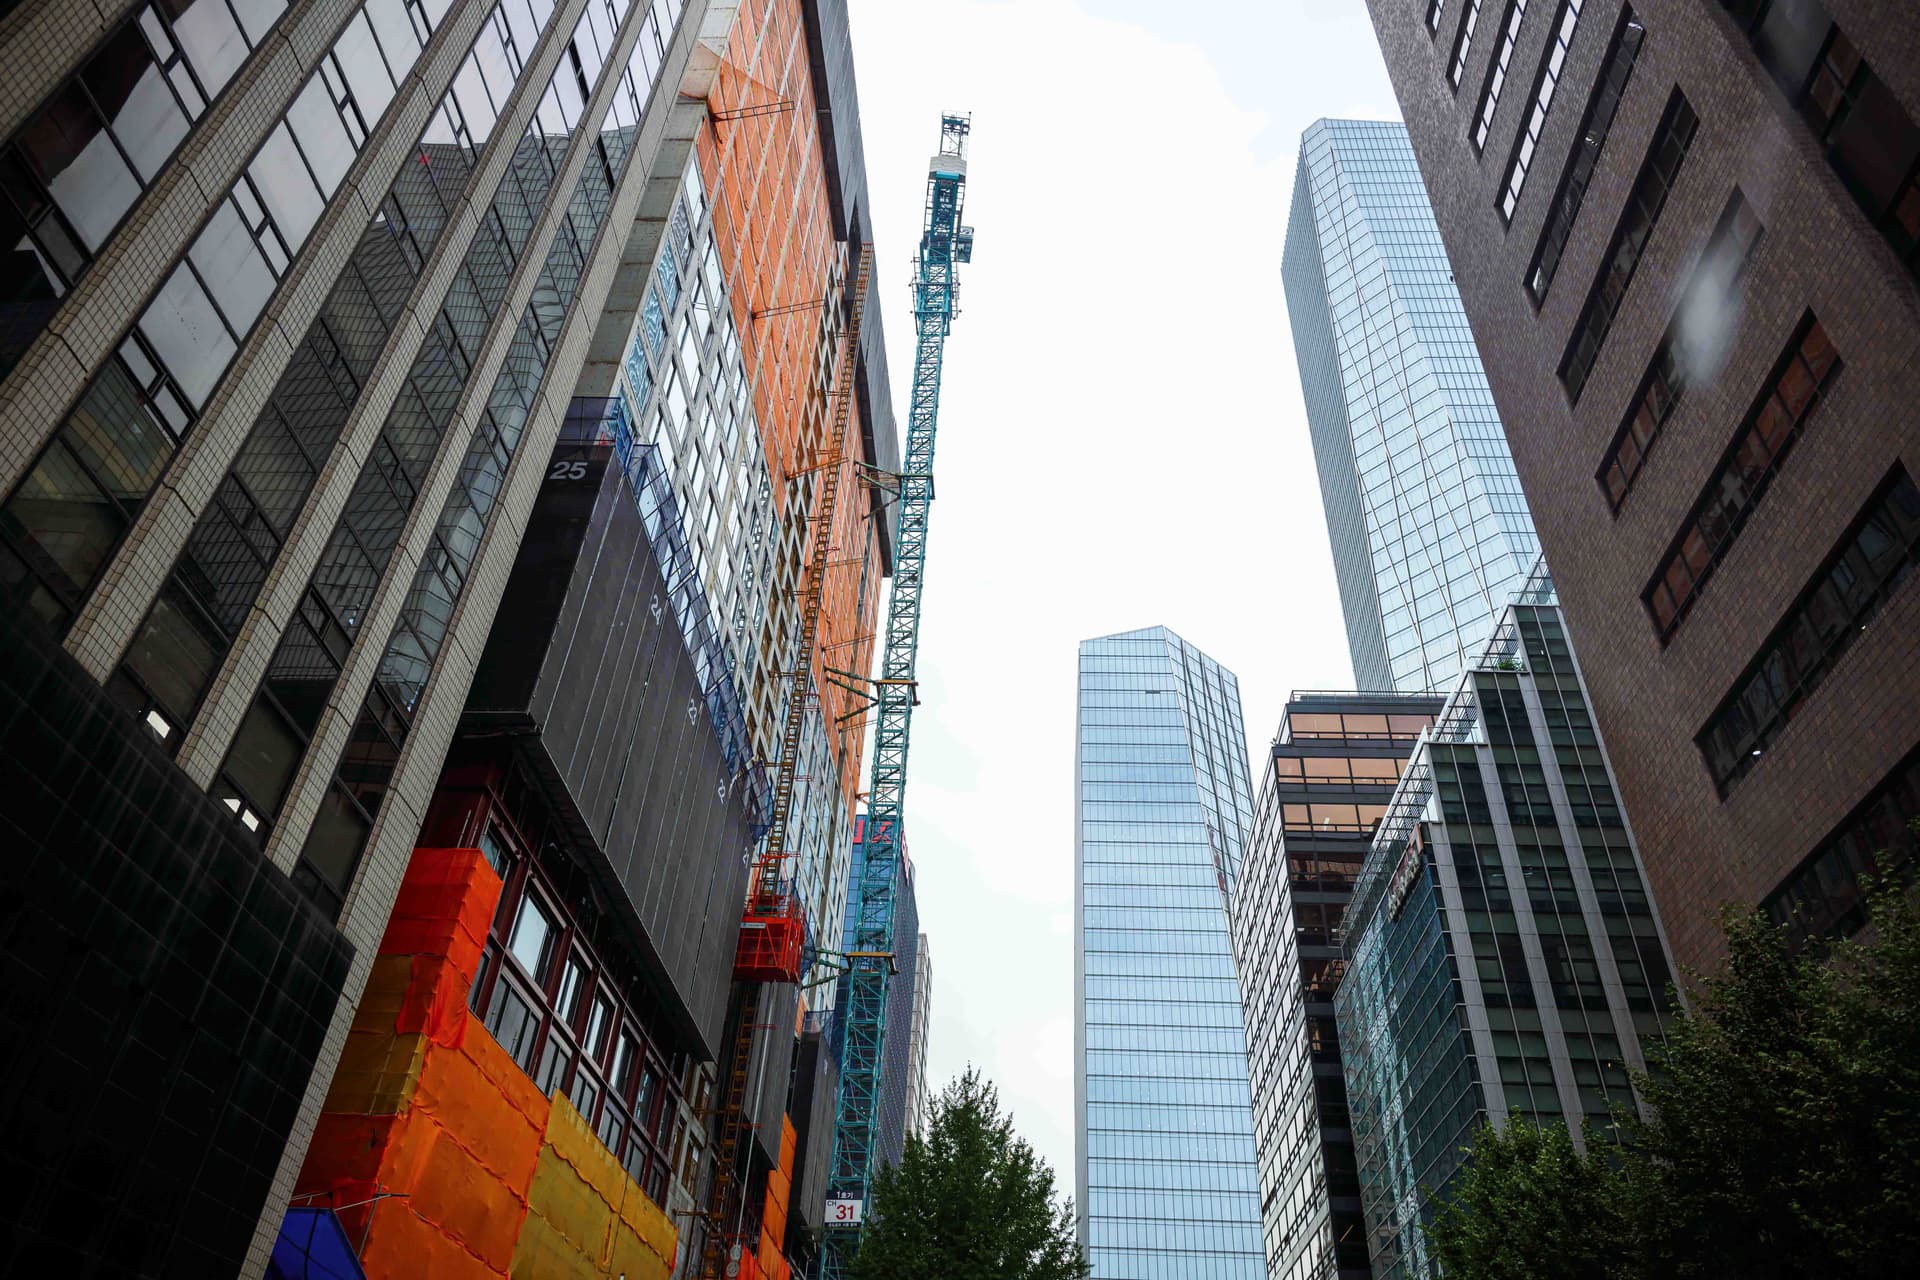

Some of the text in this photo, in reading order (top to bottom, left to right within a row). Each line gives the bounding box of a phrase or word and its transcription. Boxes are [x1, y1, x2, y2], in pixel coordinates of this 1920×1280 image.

[550, 461, 588, 480] 25
[651, 594, 662, 625] 24
[836, 1204, 854, 1220] 31
